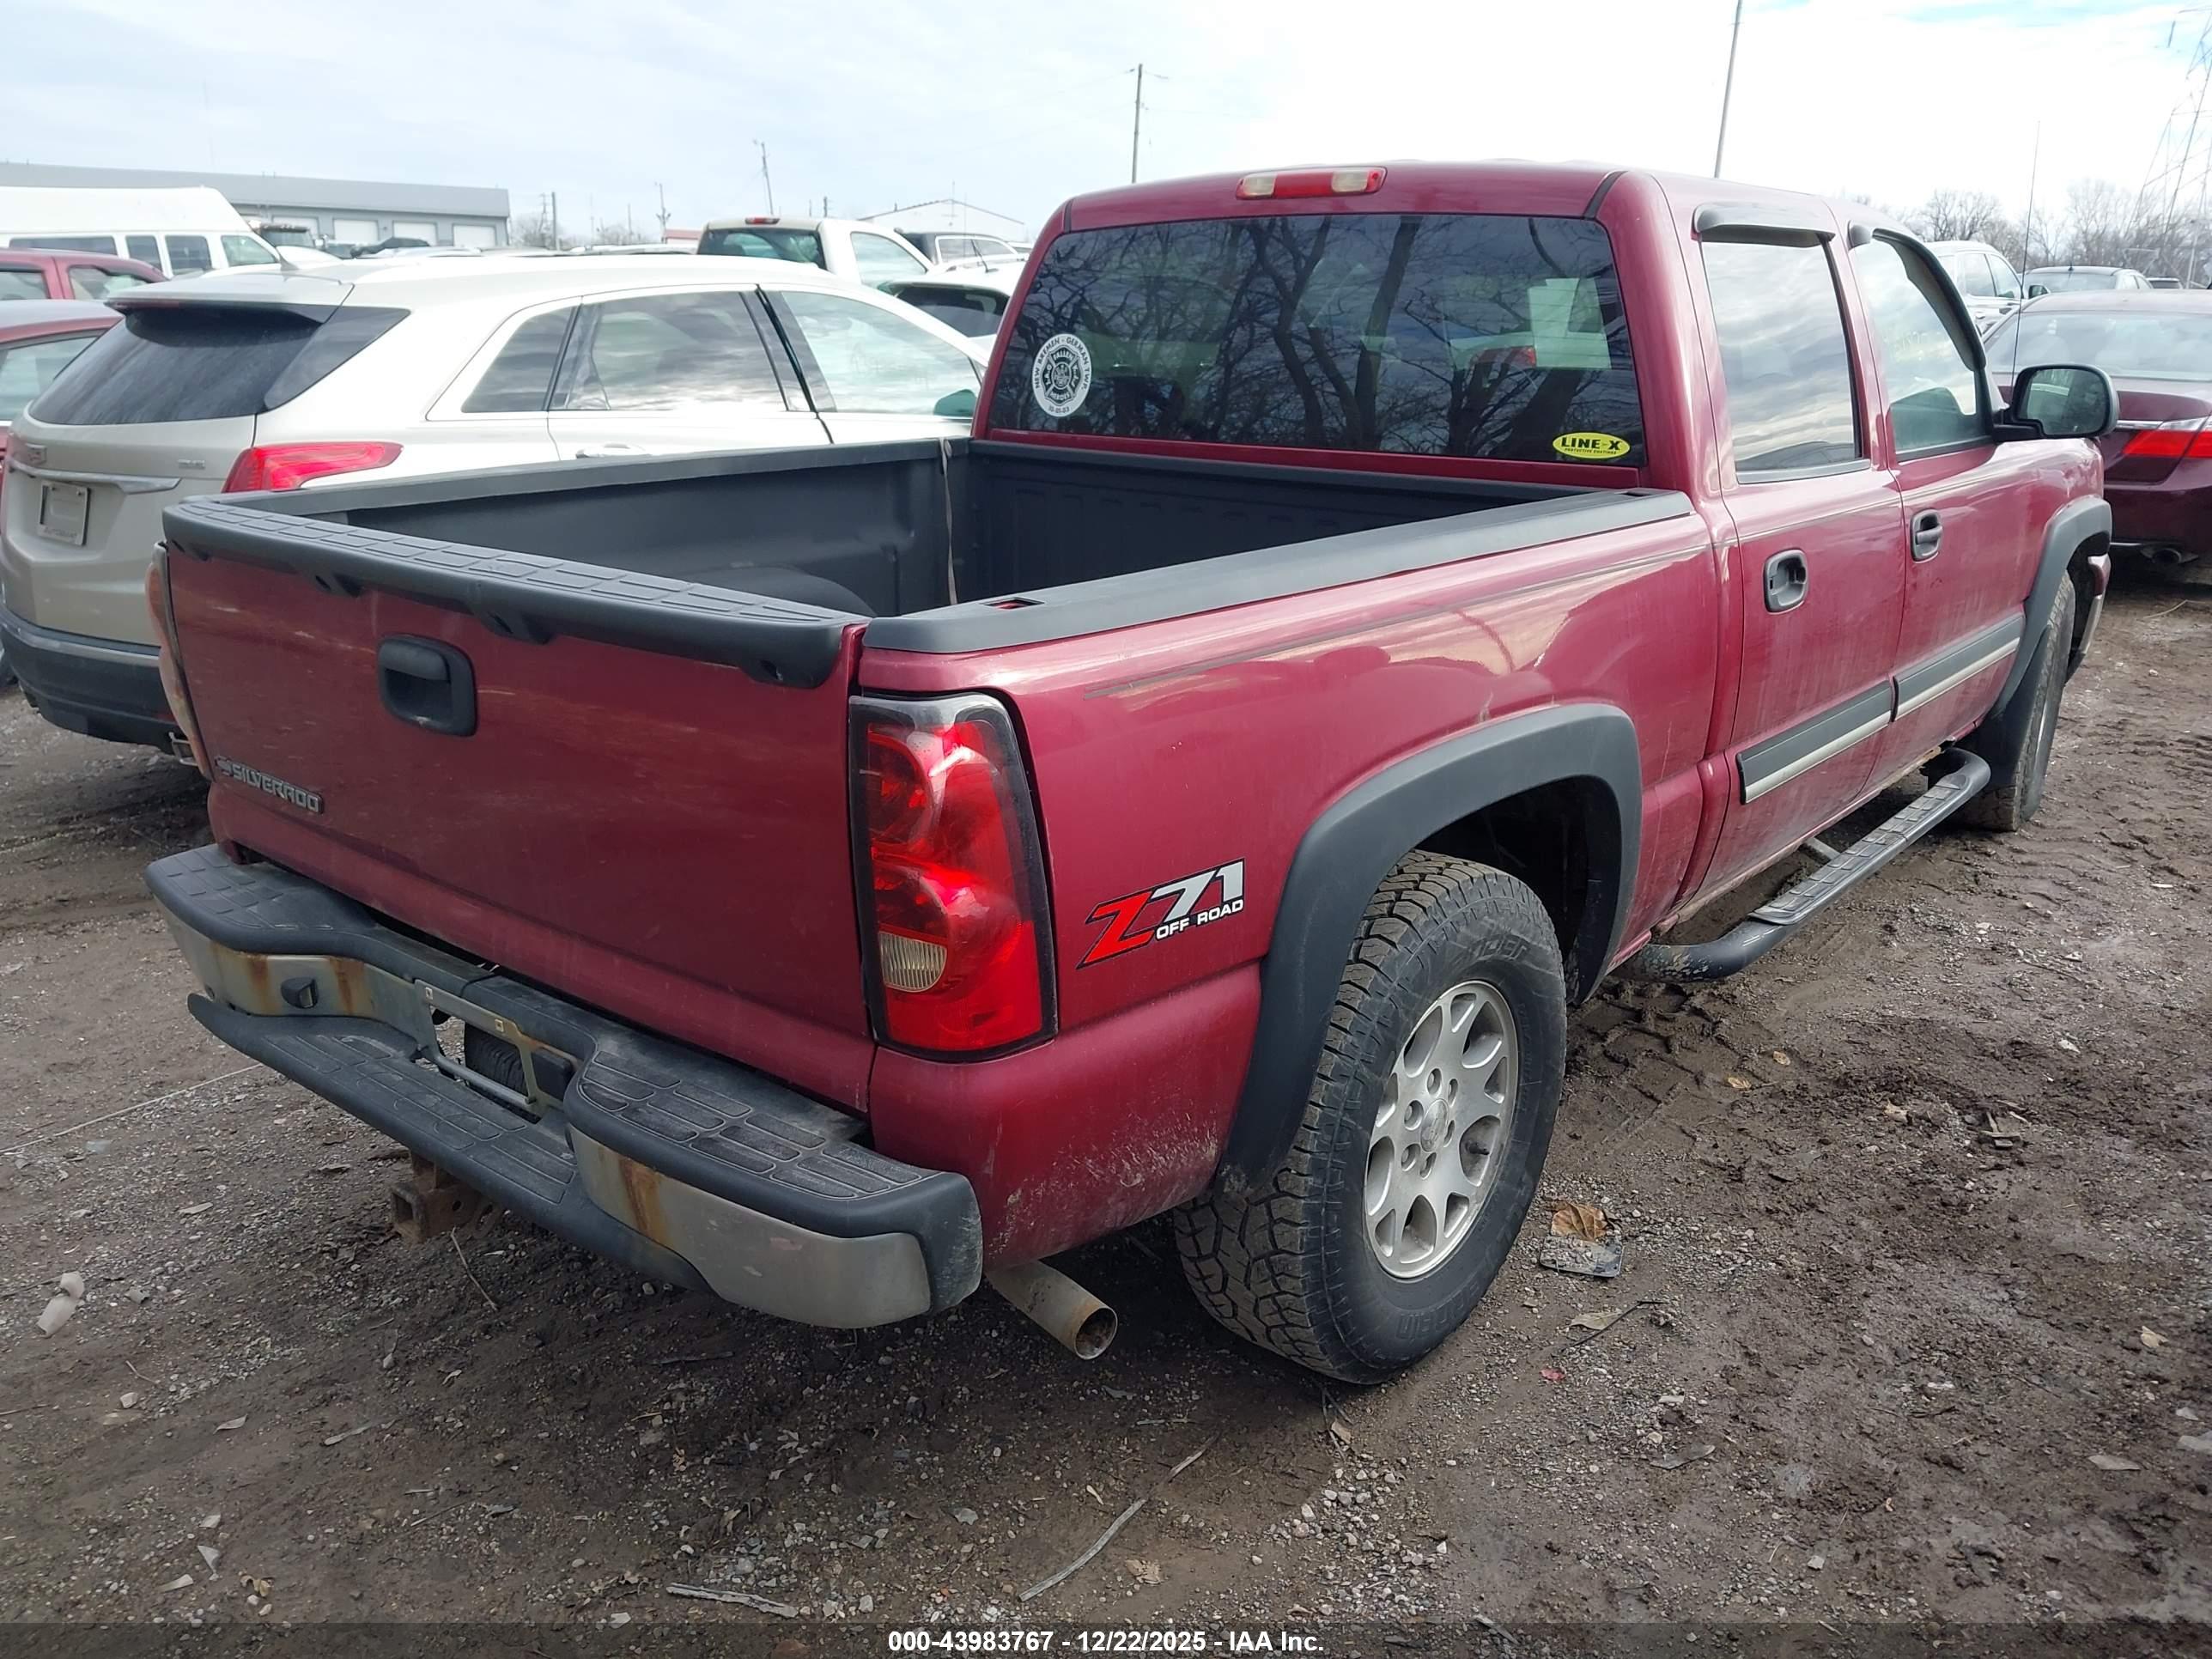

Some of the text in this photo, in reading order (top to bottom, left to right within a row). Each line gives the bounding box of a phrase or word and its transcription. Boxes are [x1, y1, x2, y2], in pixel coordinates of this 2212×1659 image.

[1561, 437, 1622, 451] LINE-X
[232, 763, 319, 812] SILVERADO
[1079, 860, 1245, 968] Z71
[1155, 898, 1244, 940] OFF ROAD
